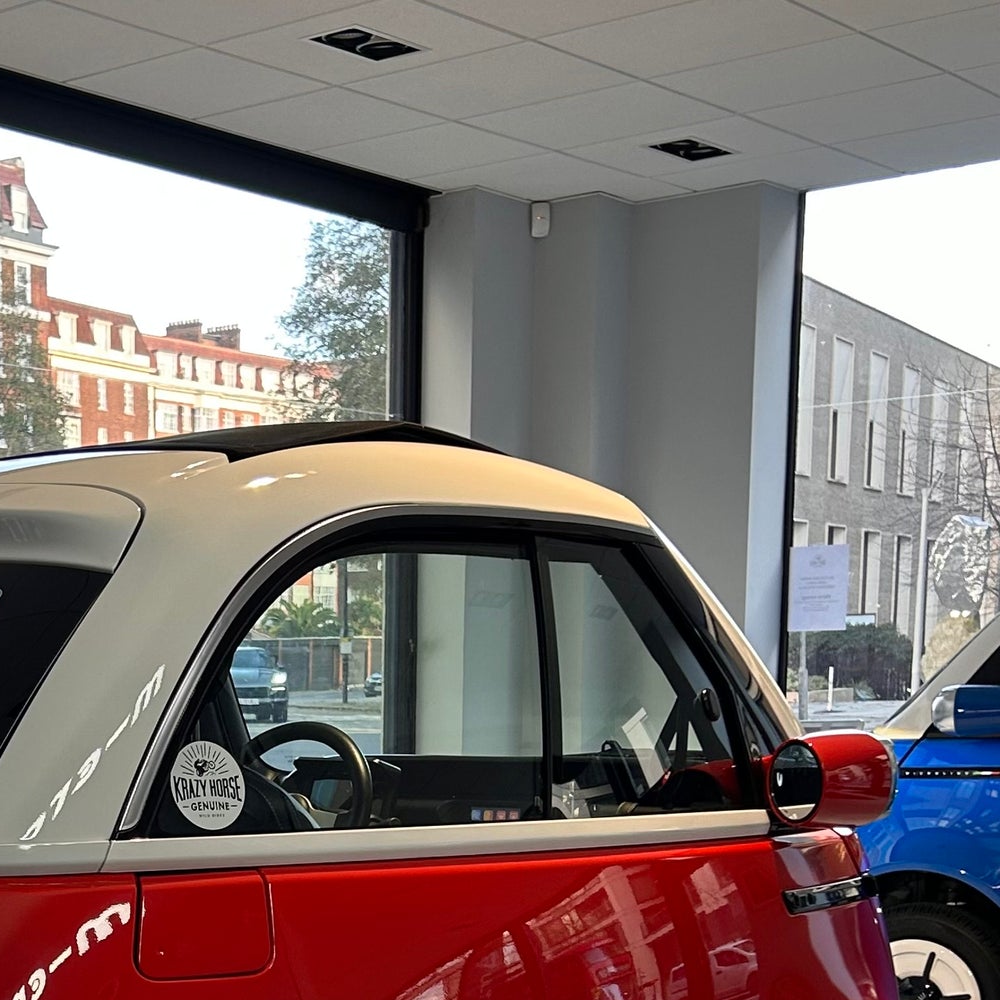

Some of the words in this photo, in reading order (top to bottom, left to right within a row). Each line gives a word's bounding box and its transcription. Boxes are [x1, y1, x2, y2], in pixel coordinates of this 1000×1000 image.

[173, 775, 207, 803] KRAZY
[209, 775, 242, 802] HORSE
[190, 801, 230, 811] GENUINE
